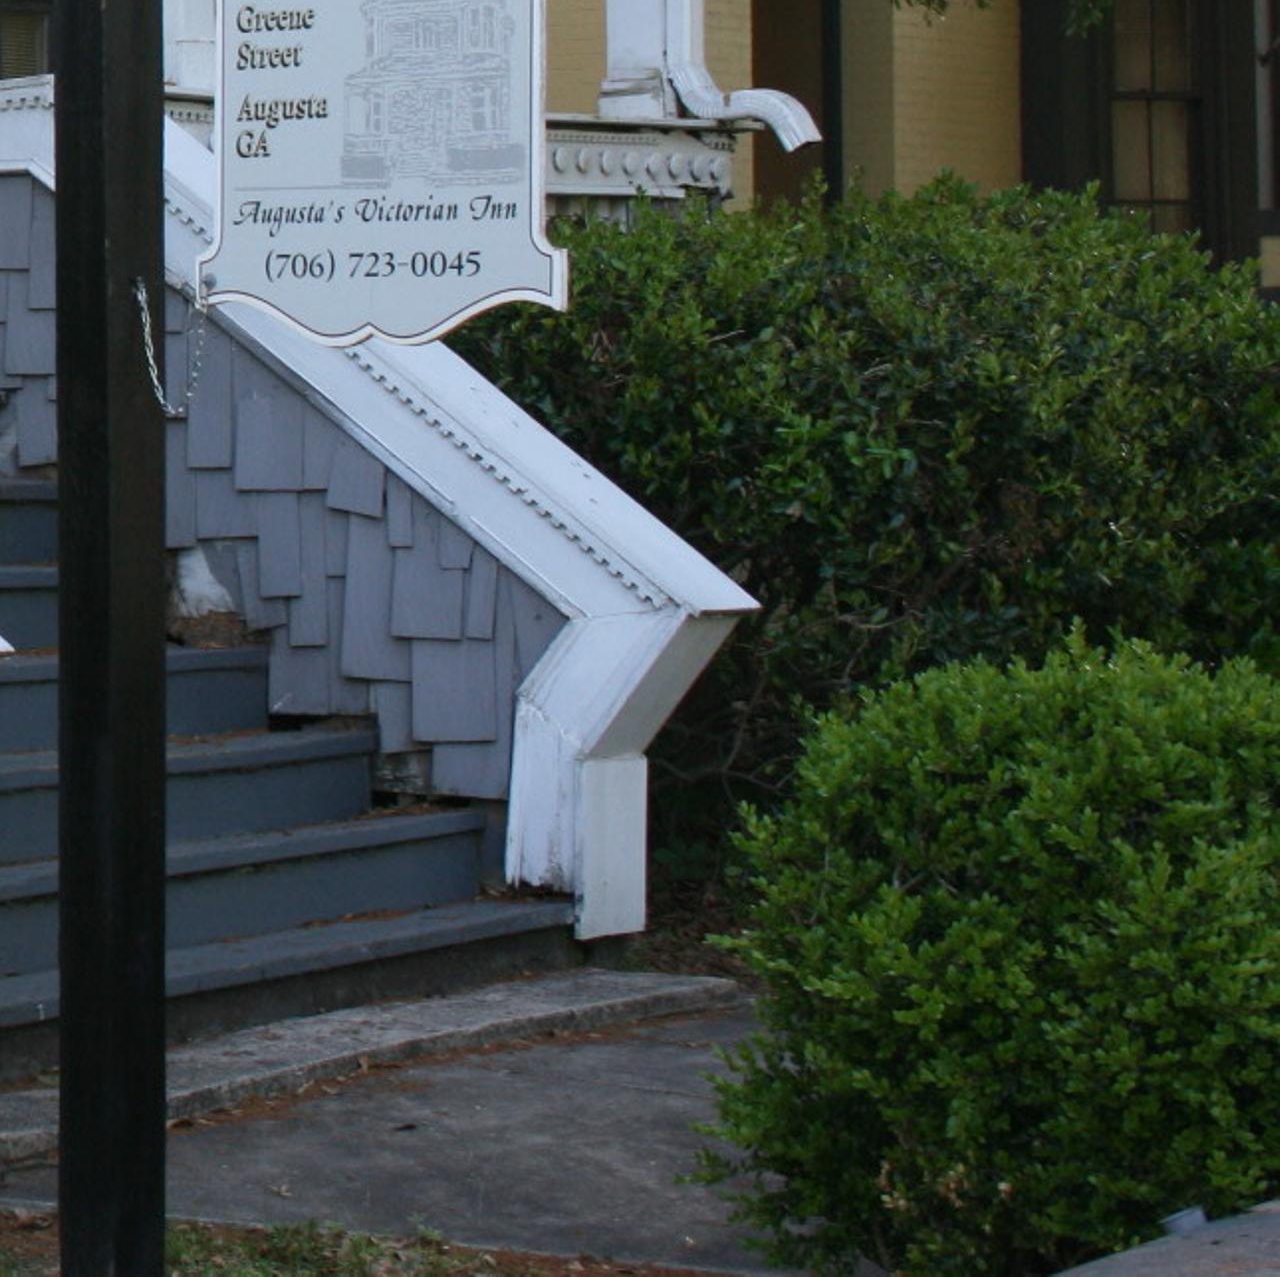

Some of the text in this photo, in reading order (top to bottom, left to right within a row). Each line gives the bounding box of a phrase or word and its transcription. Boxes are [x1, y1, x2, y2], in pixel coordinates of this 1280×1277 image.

[236, 6, 315, 33] Greene
[236, 43, 303, 70] Street
[237, 93, 328, 128] Augusta
[236, 131, 271, 158] GA
[233, 194, 517, 237] Augusta's Victorian Inn
[265, 249, 481, 283] (706) 723-0045
